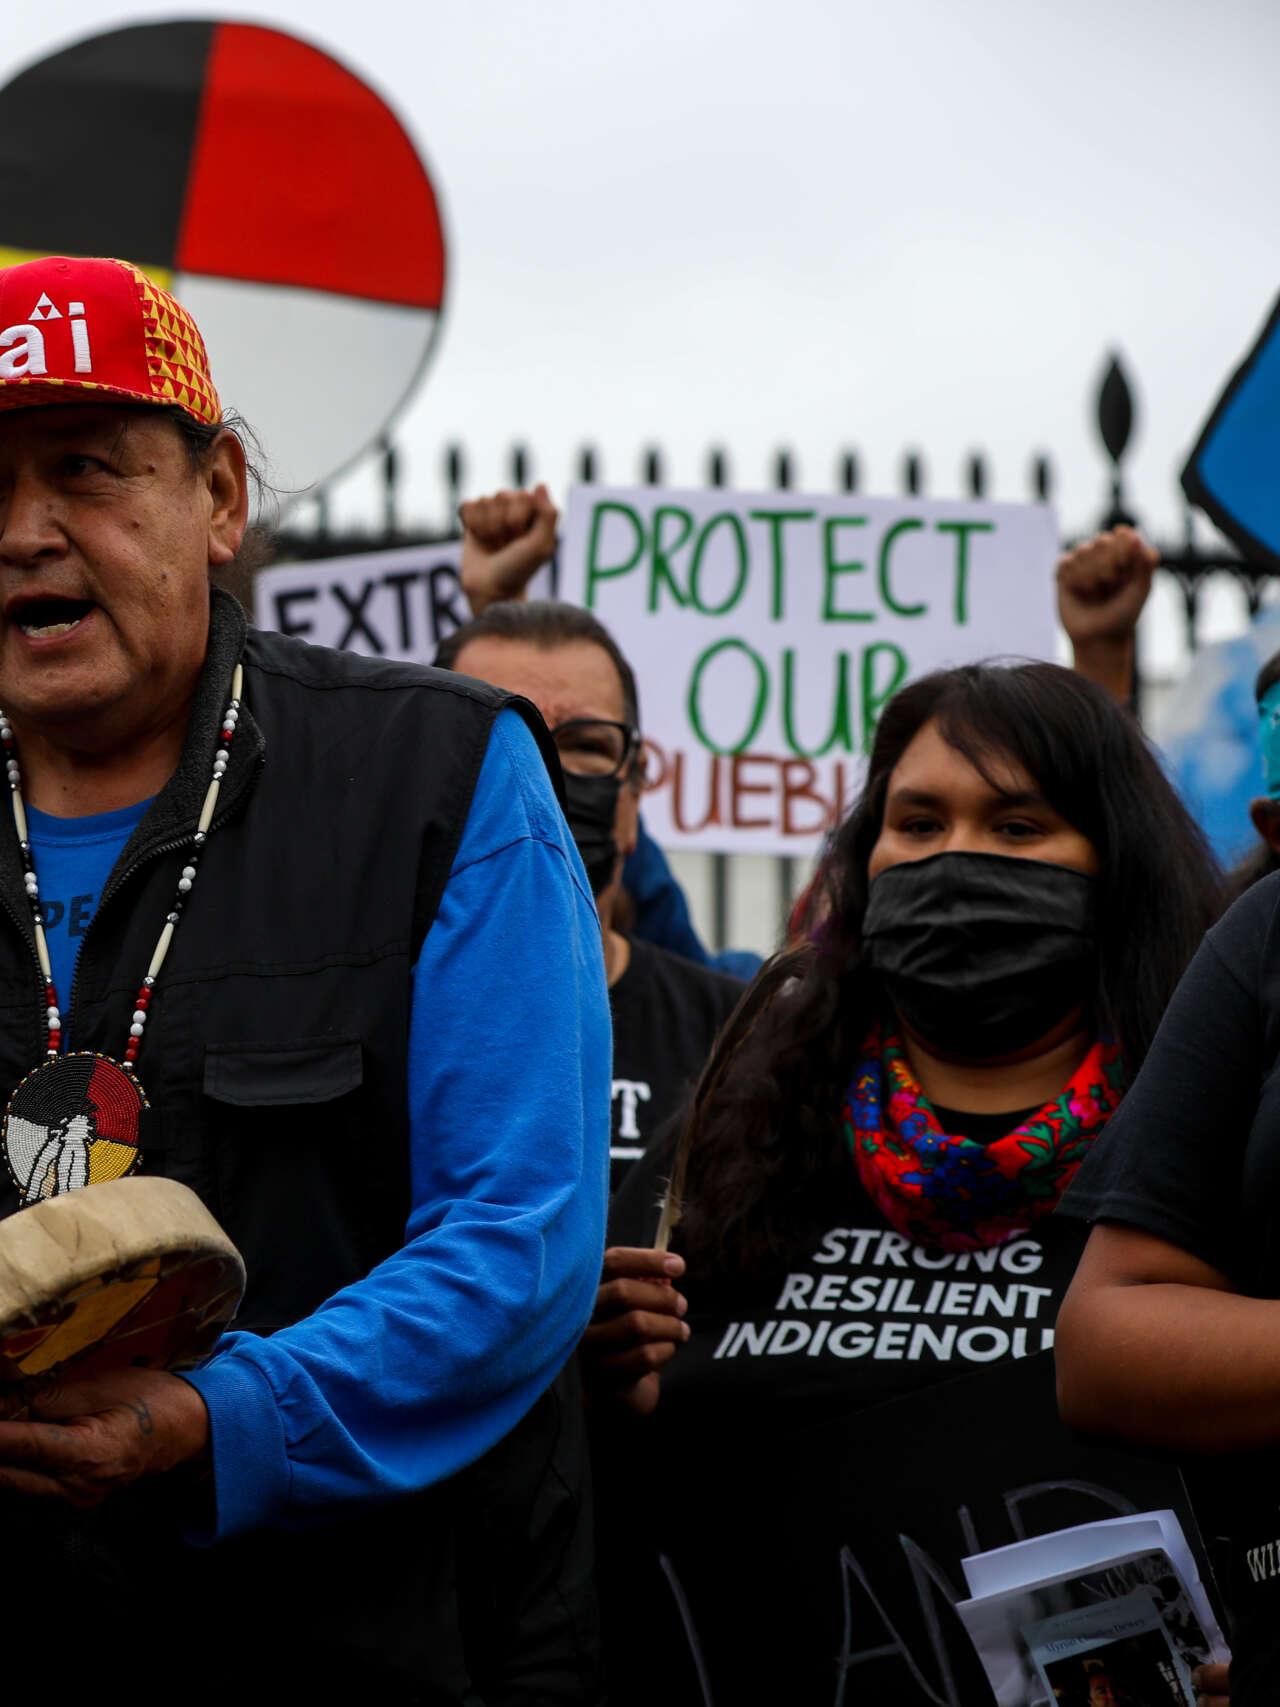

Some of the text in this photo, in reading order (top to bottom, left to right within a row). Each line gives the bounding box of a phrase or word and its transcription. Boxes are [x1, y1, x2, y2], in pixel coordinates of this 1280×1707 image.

[584, 500, 997, 627] PROTECT
[812, 1229, 1044, 1275] STRONG
[774, 1272, 1053, 1319] RESILIENT
